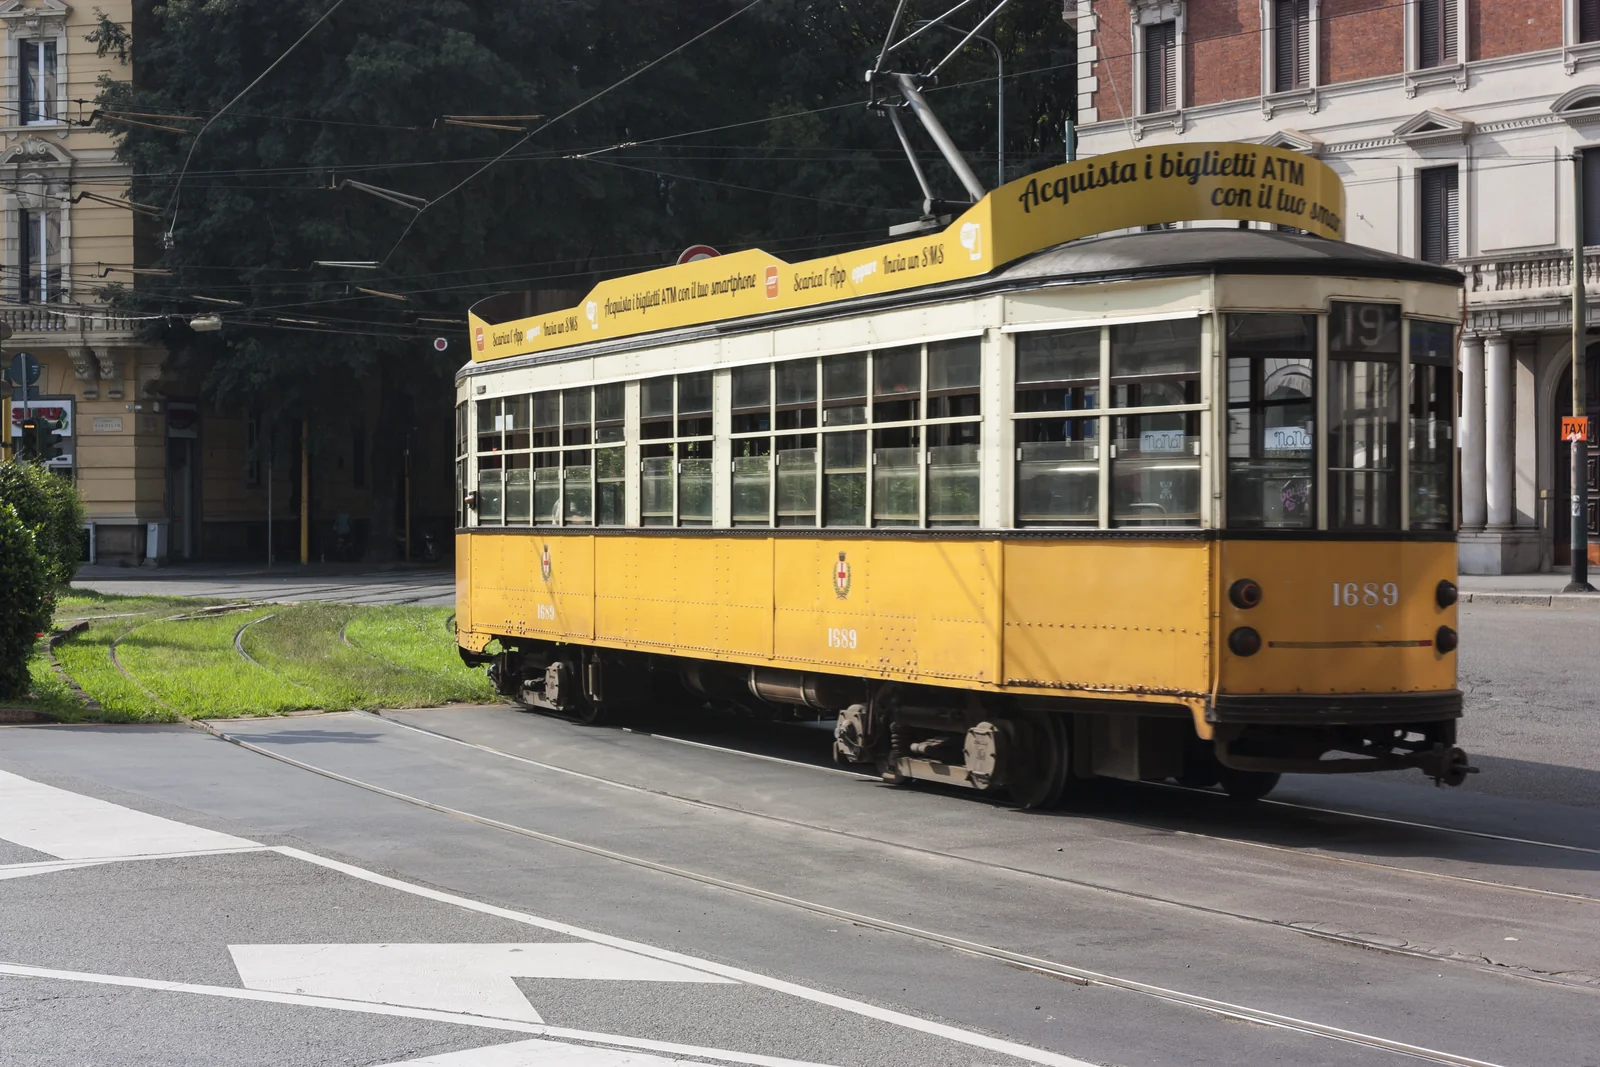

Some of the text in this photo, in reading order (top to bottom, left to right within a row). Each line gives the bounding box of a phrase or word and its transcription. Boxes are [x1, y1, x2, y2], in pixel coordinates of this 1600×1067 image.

[1018, 151, 1305, 213] Acquista i biglietti ATM
[1211, 187, 1252, 207] con
[1258, 184, 1273, 209] il
[1277, 188, 1307, 215] tuo
[793, 271, 823, 291] Scarica
[883, 254, 906, 274] Invia
[908, 255, 919, 268] un
[922, 243, 944, 267] SMS
[604, 297, 631, 319] Acquista
[636, 288, 660, 314] biglietti
[661, 286, 677, 305] ATM
[678, 287, 690, 302] con
[697, 281, 709, 298] tuo
[711, 272, 756, 298] smartphone
[1344, 304, 1384, 347] 19
[1563, 423, 1586, 435] TAXI
[1333, 582, 1399, 607] 1689
[537, 603, 555, 620] 1689
[828, 627, 857, 649] 1689
